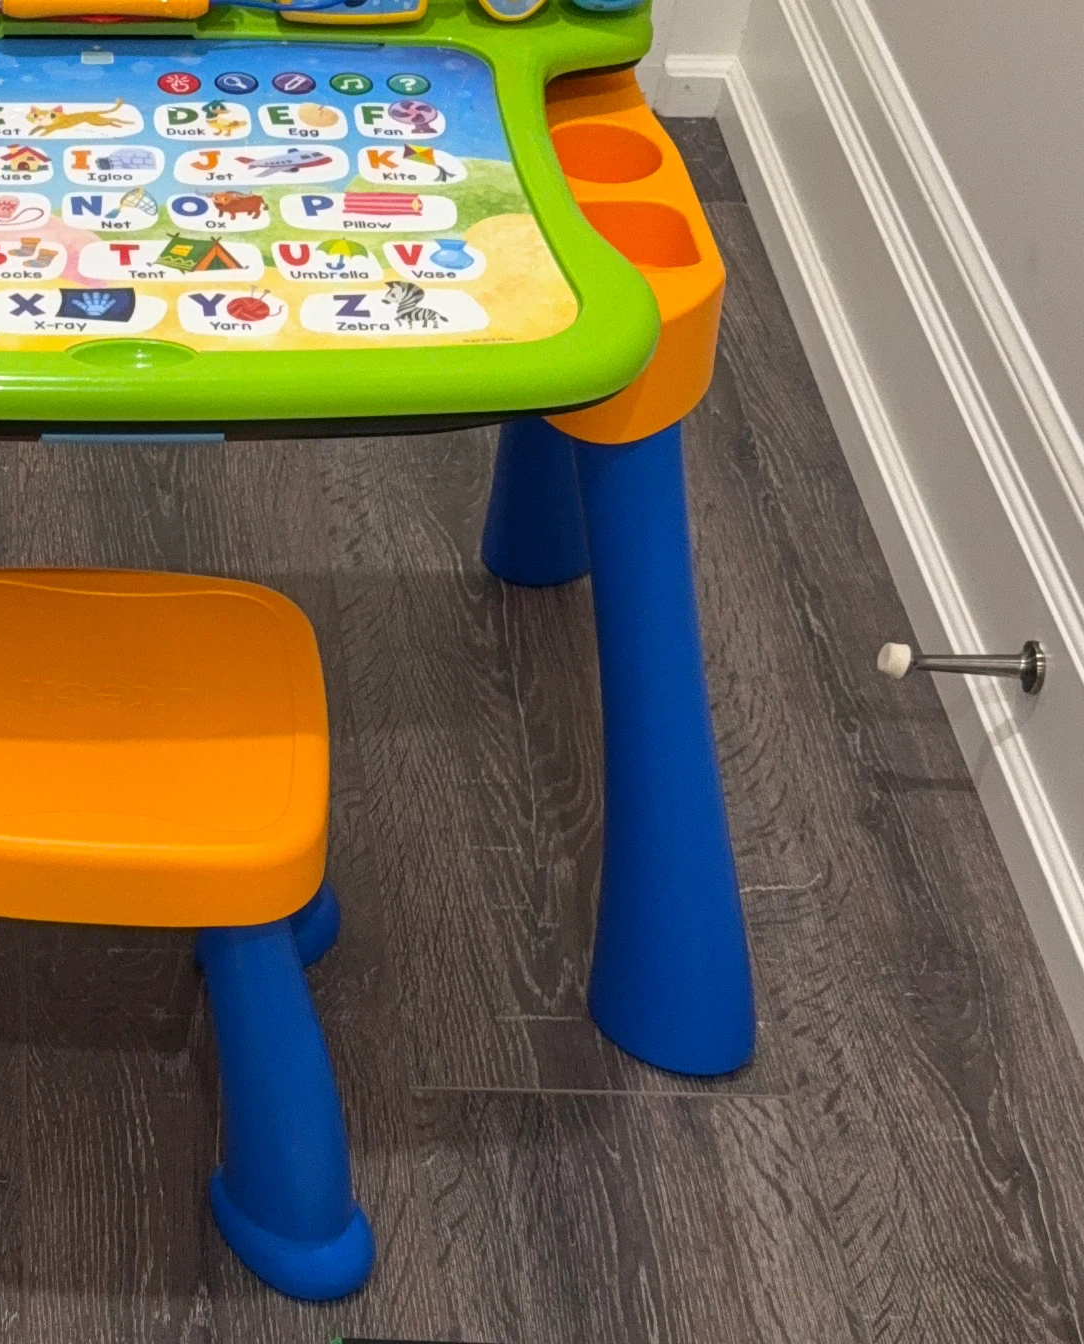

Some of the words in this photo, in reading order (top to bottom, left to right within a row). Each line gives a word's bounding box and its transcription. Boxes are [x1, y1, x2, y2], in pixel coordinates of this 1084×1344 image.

[167, 106, 199, 126] D
[267, 106, 295, 126] E
[360, 106, 386, 126] F
[166, 127, 206, 136] Duck
[288, 128, 319, 138] Egg
[374, 127, 404, 136] Fan
[70, 150, 92, 170] I
[191, 150, 221, 170] J
[366, 149, 398, 169] K
[87, 172, 134, 182] Igloo
[205, 172, 234, 182] Jet
[382, 172, 417, 182] Kite
[70, 196, 104, 216] N
[171, 196, 210, 216] O
[301, 196, 334, 216] P
[100, 220, 132, 230] Net
[205, 220, 228, 230] Ox
[342, 219, 392, 230] Pillow
[110, 244, 141, 266] T
[278, 244, 311, 266] U
[392, 244, 424, 266] V
[128, 270, 166, 280] Tent
[290, 269, 370, 280] Umbrella
[411, 270, 456, 280] Vase
[8, 293, 46, 317] X
[190, 293, 226, 318] Y
[332, 294, 372, 318] Z
[34, 320, 86, 332] X-ray
[209, 322, 252, 332] Yarn
[336, 321, 390, 332] Zebra
